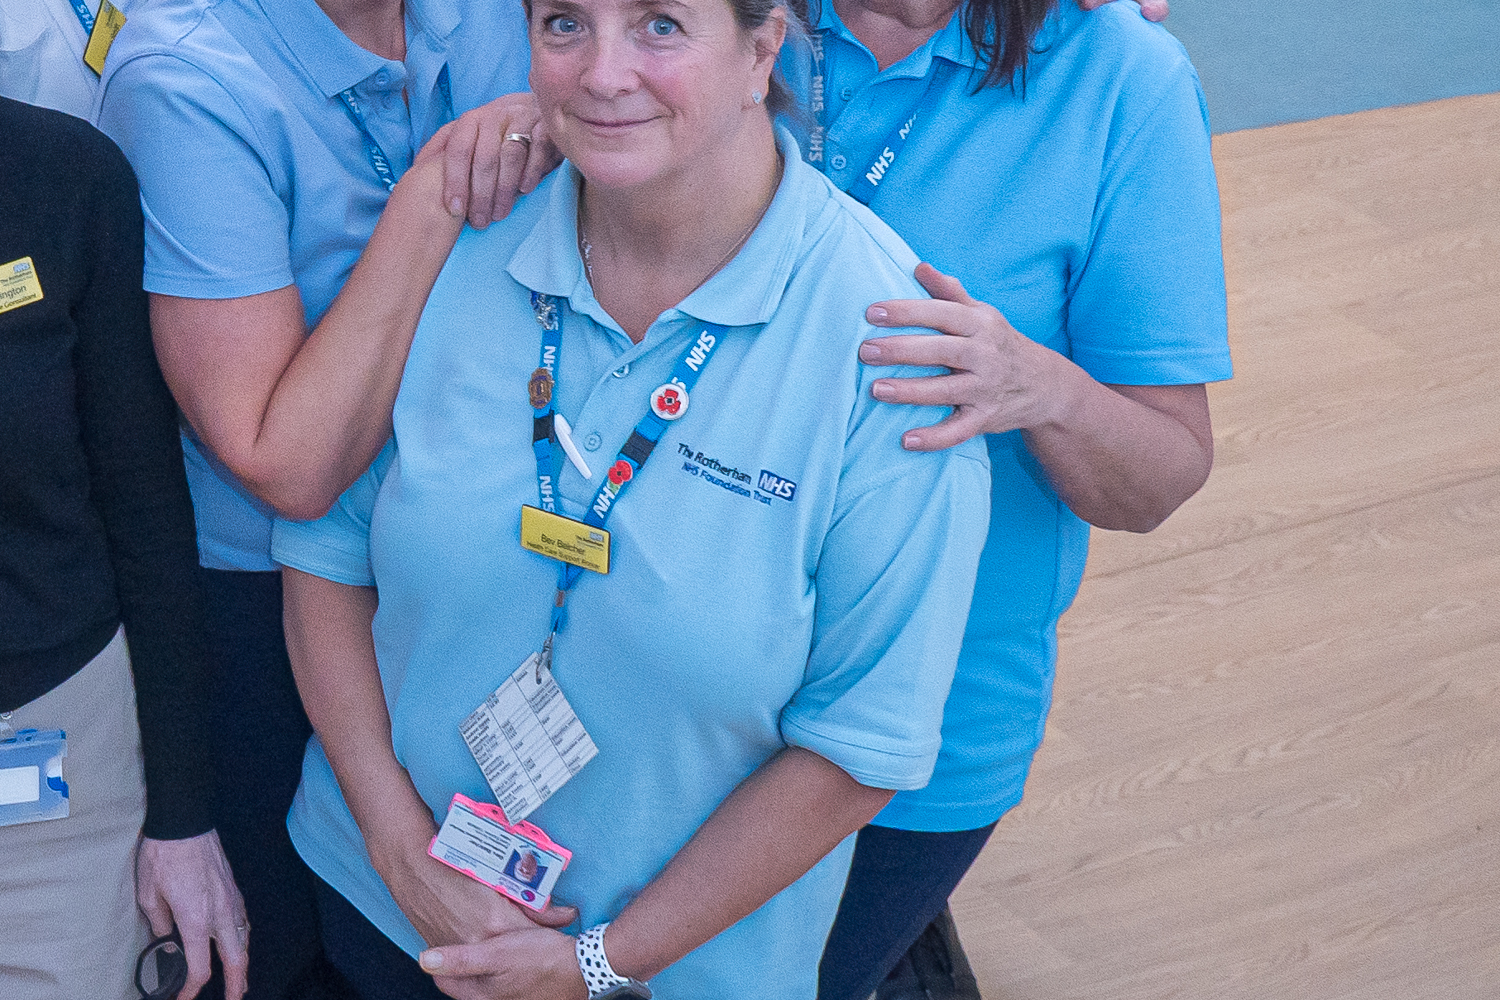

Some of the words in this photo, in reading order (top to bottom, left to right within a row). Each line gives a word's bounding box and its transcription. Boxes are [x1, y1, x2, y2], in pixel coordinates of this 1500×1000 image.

[77, 4, 94, 29] HS
[809, 126, 824, 161] NHS
[866, 146, 895, 187] NHS
[544, 345, 556, 374] NH
[685, 330, 716, 372] NHS
[678, 442, 694, 459] The
[694, 452, 752, 485] Rotherham
[593, 484, 616, 519] NH
[760, 472, 795, 498] NHS
